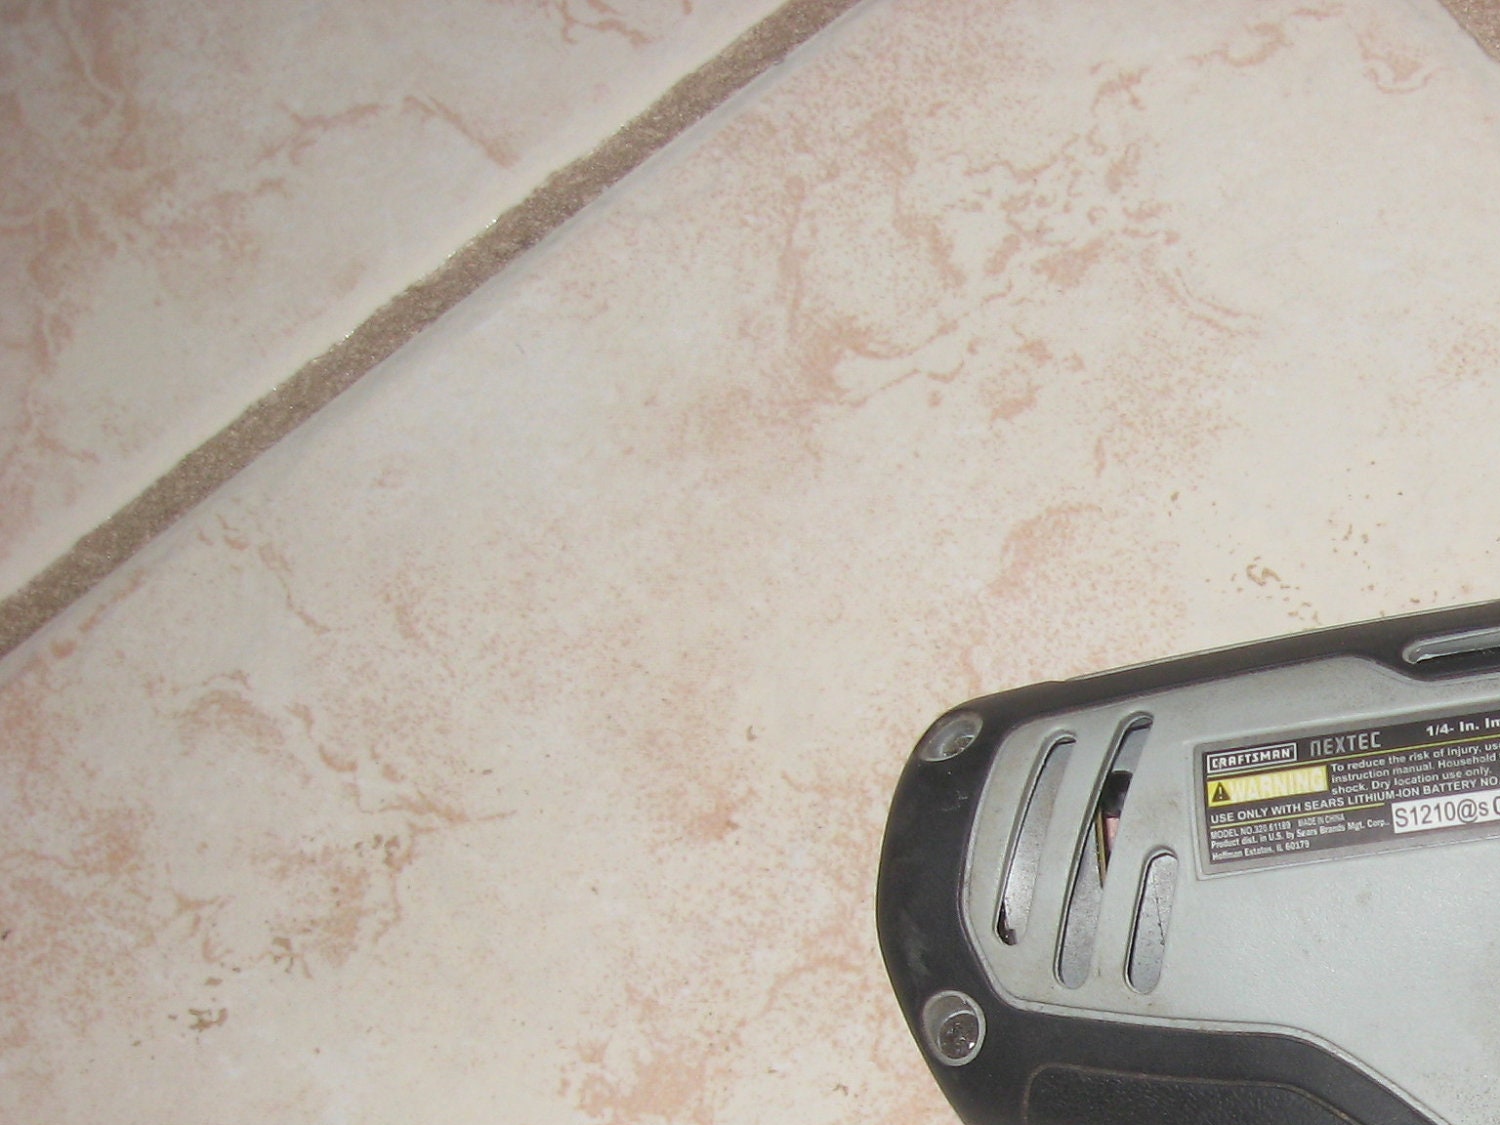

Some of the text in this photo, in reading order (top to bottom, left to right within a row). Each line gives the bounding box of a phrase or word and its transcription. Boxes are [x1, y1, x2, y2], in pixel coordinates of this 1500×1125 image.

[1460, 721, 1479, 732] In.
[1212, 748, 1290, 769] CRAFTSMAN
[1331, 763, 1344, 773] To
[1347, 758, 1385, 771] reduce
[1389, 754, 1406, 764] the
[1409, 748, 1429, 761] risk
[1433, 749, 1445, 758] of
[1331, 768, 1389, 783] instruction
[1393, 764, 1433, 775] manual.
[1438, 754, 1496, 769] Household
[1230, 767, 1323, 800] WARNING
[1331, 765, 1492, 796] shock. Dry location use only.
[1211, 811, 1235, 824] USE
[1238, 807, 1268, 821] ONLY
[1271, 803, 1300, 816] WITH
[1304, 797, 1345, 811] SEARS
[1348, 786, 1420, 806] LITHIUM-ION
[1424, 779, 1476, 795] BATTERY
[1211, 828, 1239, 840] MODEL
[1297, 818, 1316, 827] MADE
[1318, 817, 1324, 825] IN
[1325, 813, 1345, 825] CHINA
[1211, 838, 1240, 849] Product
[1268, 832, 1284, 841] U.S.
[1286, 830, 1295, 840] by
[1297, 827, 1317, 837] Sears
[1320, 824, 1345, 835] Brands
